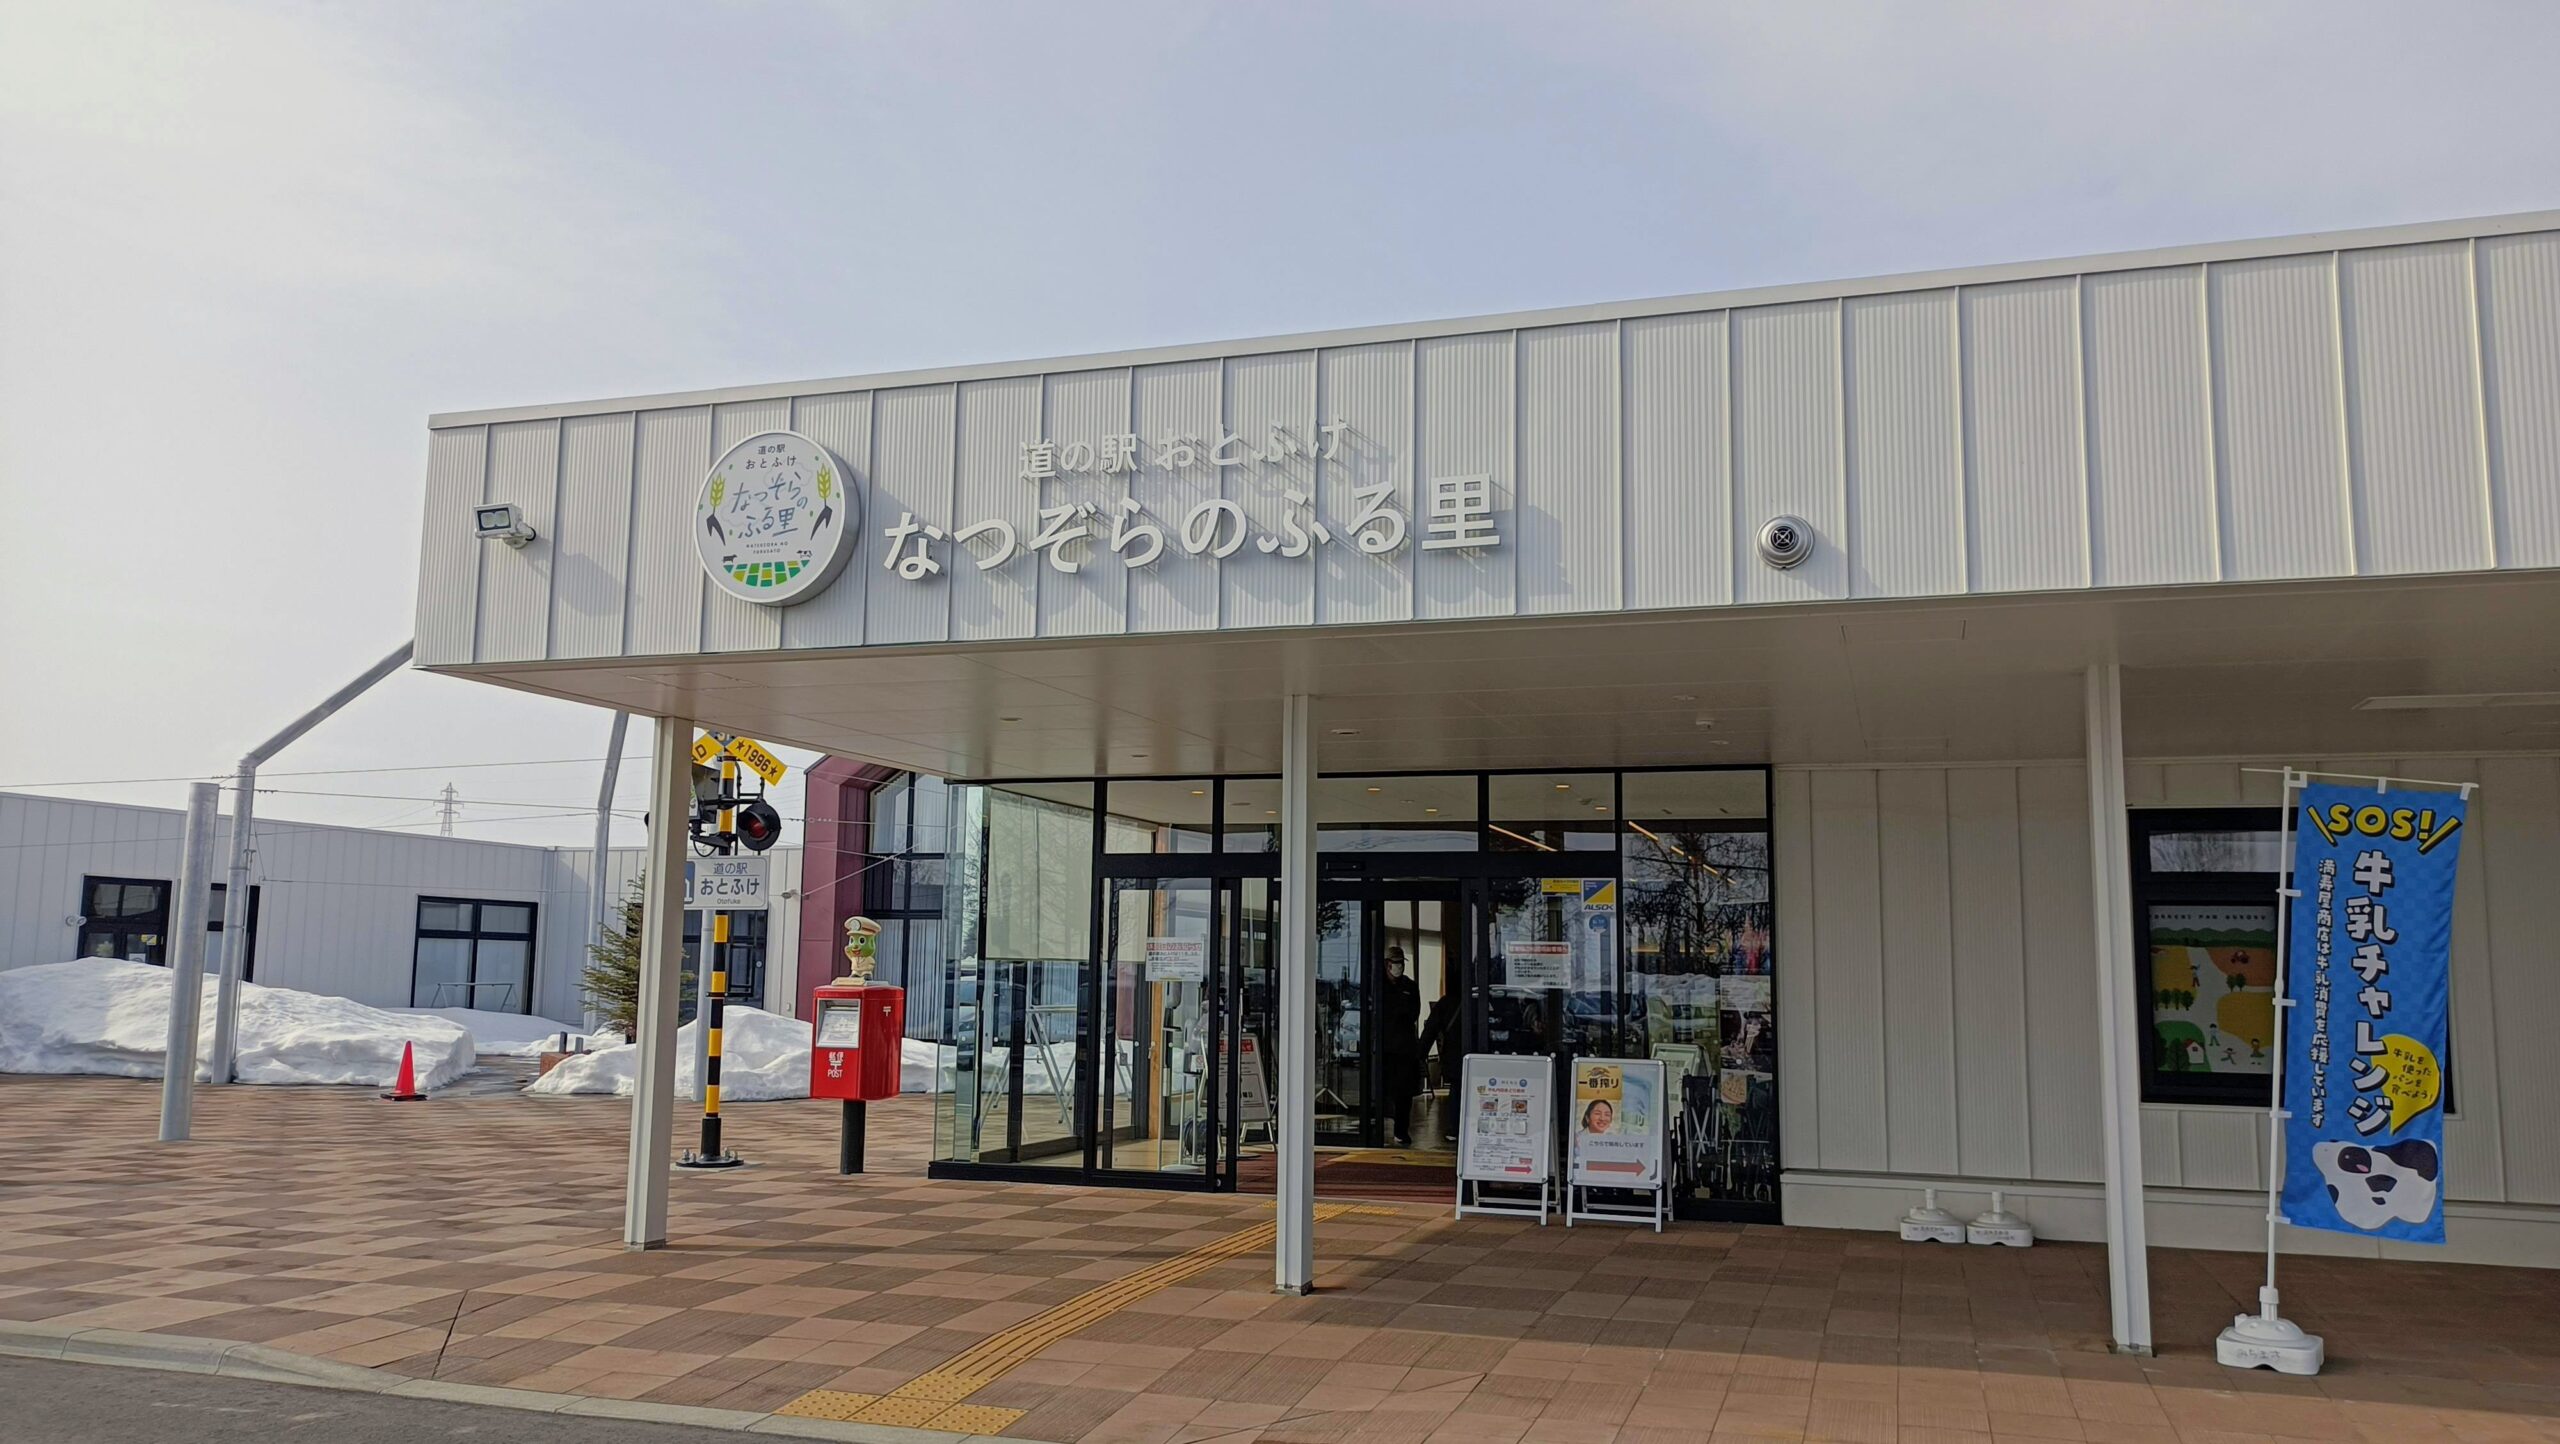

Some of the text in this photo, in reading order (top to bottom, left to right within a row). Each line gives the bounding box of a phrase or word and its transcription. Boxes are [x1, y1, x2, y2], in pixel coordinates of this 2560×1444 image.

[758, 444, 786, 455] 道の駅
[1019, 414, 1347, 478] 道の駅 おとふけ
[745, 456, 797, 470] おとふけ
[738, 506, 798, 539] ふる里
[883, 473, 1501, 581] なつぞらのふる里
[744, 744, 771, 773] 1996
[2327, 803, 2434, 841] SOS!
[713, 862, 748, 875] 道の駅
[700, 878, 760, 896] おとふけ
[2346, 850, 2398, 1136] 牛乳チャレンジ
[827, 1069, 843, 1078] POST
[1578, 1078, 1619, 1089] 一番搾り
